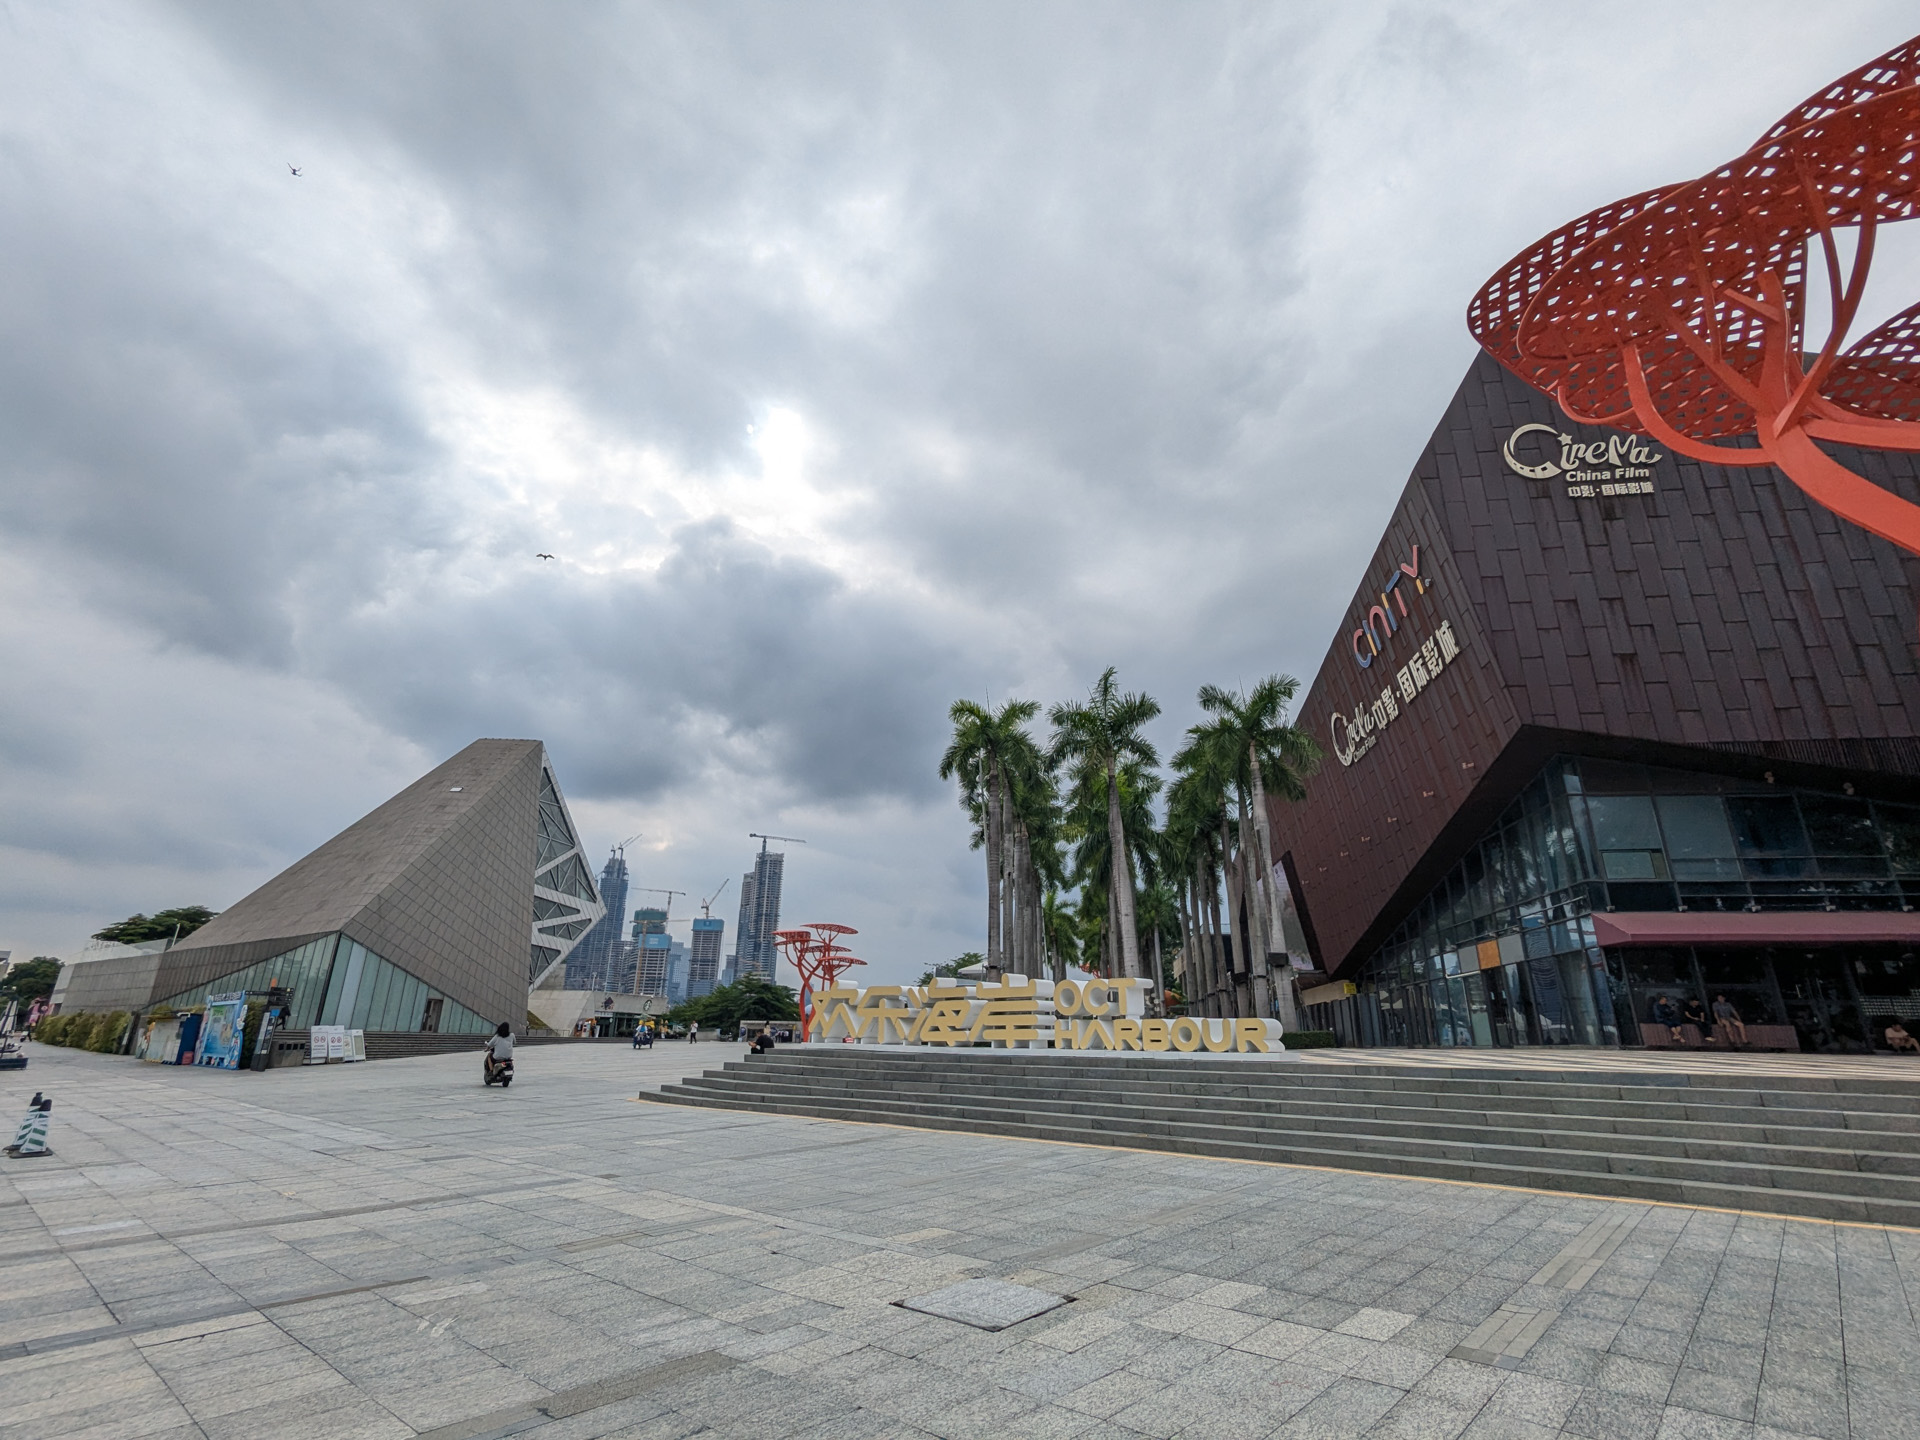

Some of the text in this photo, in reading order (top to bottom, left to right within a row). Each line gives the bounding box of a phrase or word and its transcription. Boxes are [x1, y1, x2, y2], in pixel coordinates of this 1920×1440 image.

[1565, 467, 1650, 482] China Film
[808, 973, 1045, 1049] 欢乐海岸
[1053, 978, 1137, 1016] OCT
[1054, 1017, 1271, 1053] HARBOUR
